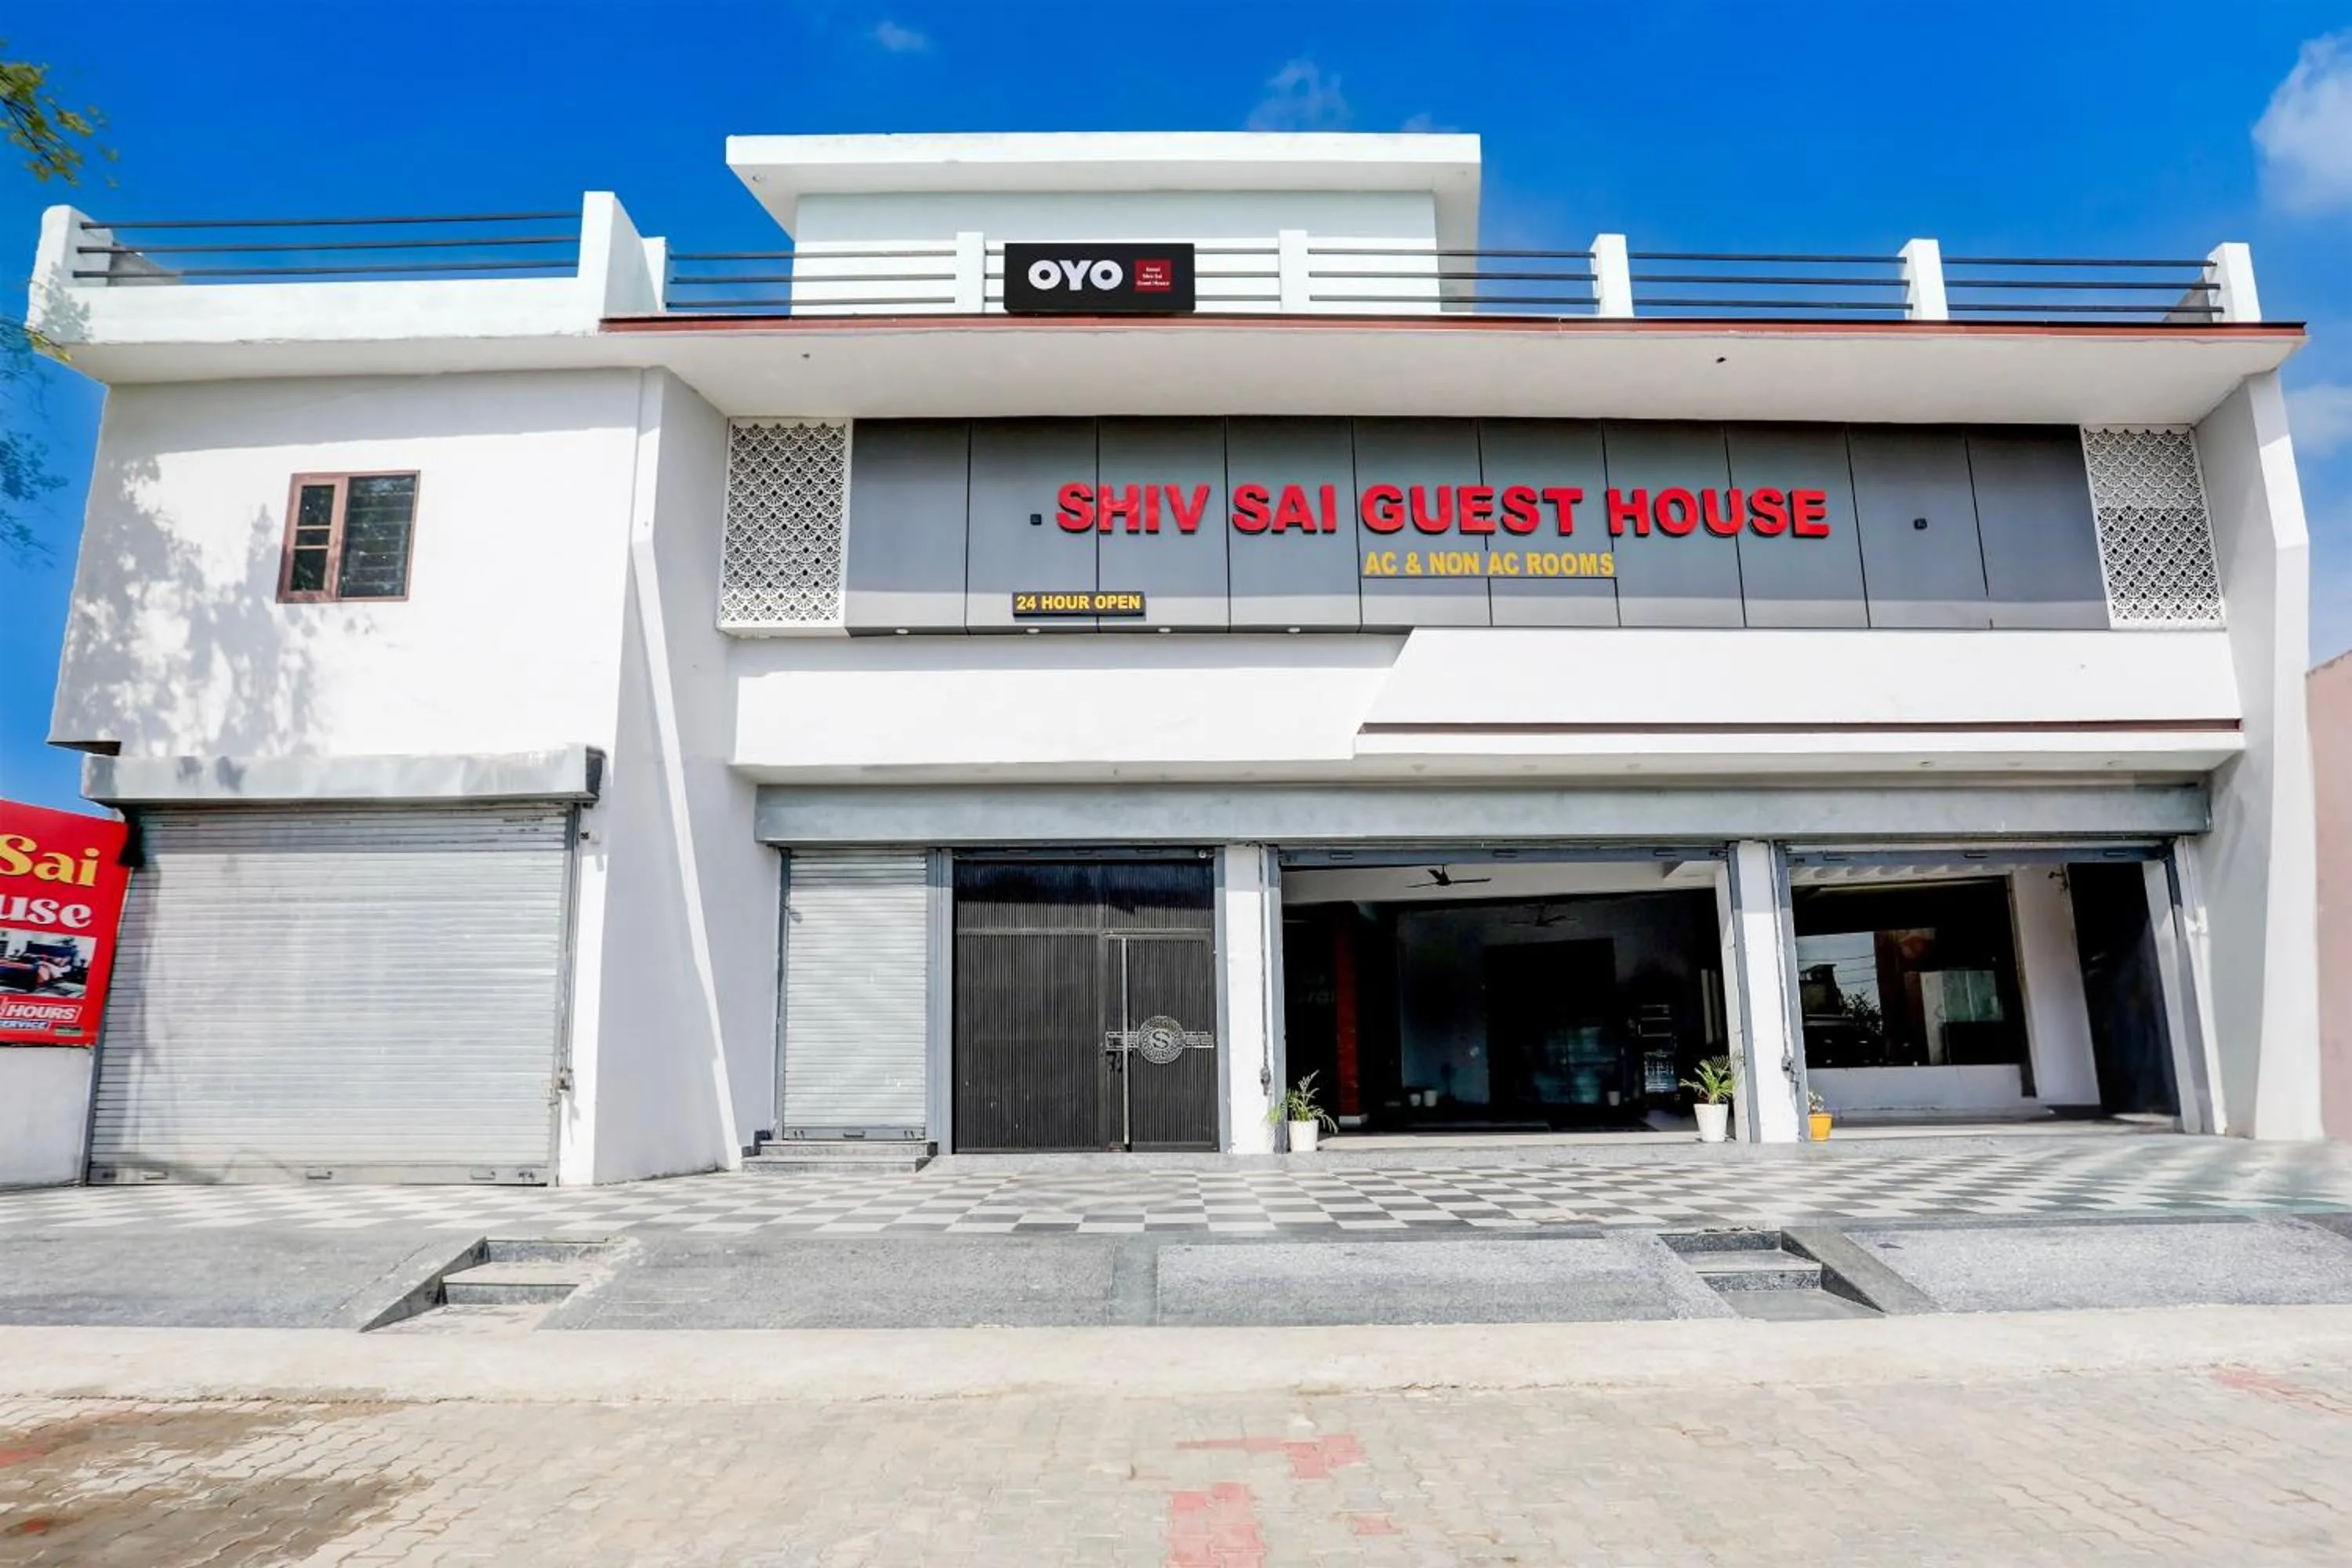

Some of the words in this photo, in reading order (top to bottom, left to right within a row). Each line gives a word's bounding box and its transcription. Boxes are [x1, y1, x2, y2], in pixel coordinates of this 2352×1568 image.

[1028, 260, 1123, 291] OYO
[1056, 483, 1210, 533] SHIV
[1232, 484, 1337, 533] SAI
[1360, 485, 1583, 535] GUEST
[1606, 486, 1831, 538] HOUSE
[1364, 551, 1398, 575] AC
[1405, 551, 1422, 575] &
[1429, 551, 1480, 575] NON
[1488, 551, 1519, 575] AC
[1526, 552, 1614, 576] ROOMS
[1016, 595, 1036, 610] 24
[1041, 595, 1090, 610] HOUR
[1094, 595, 1141, 610] OPEN
[0, 833, 100, 887] Sai
[5, 1004, 77, 1020] HOURS
